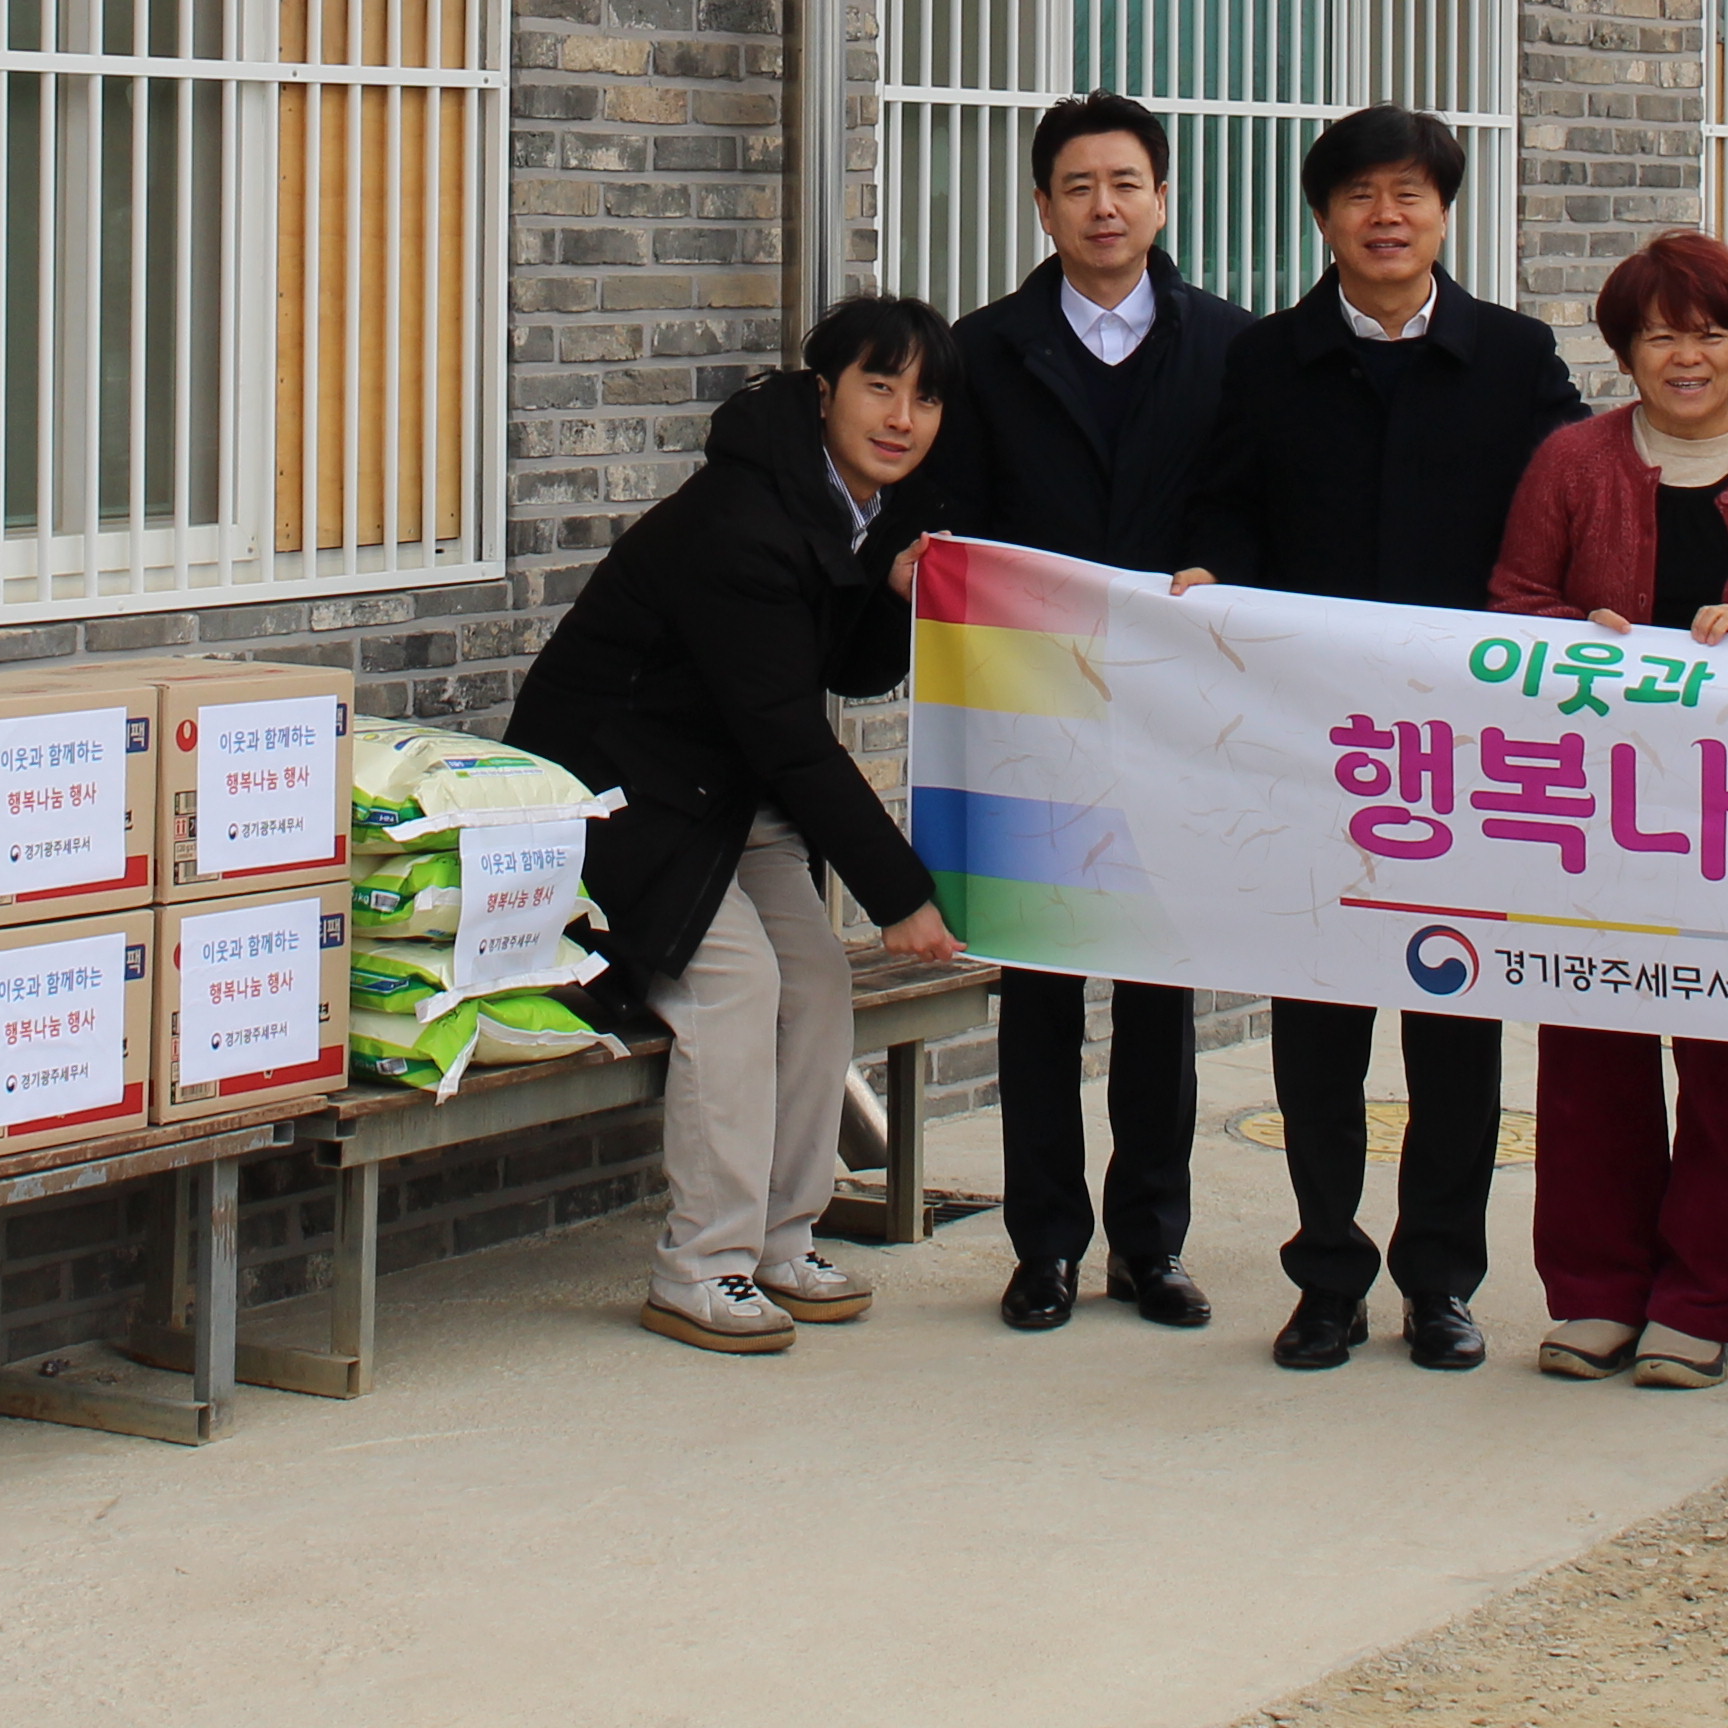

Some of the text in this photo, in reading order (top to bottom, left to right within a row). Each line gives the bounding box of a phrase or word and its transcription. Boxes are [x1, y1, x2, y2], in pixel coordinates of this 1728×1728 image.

[1468, 635, 1715, 718] 이웃과
[220, 725, 316, 754] 이웃과 함께하는
[0, 739, 104, 771] 이웃과 함께하는
[226, 765, 309, 795] 행복나눔 행사
[7, 781, 96, 815] 행복나눔 행사
[241, 817, 303, 838] 경기광주세무서
[24, 836, 90, 860] 경기광주세무서
[481, 848, 567, 876] 이웃과 함께하는
[487, 885, 554, 913] 행복나눔 행사
[203, 937, 243, 964] 이웃과
[247, 930, 300, 957] 함께하는
[487, 932, 540, 954] 경기광주세무서
[46, 966, 103, 996] 함께하는
[209, 969, 294, 1005] 행복나눔 행사
[4, 1008, 96, 1046] 행복나눔 행사
[225, 1021, 288, 1047] 경기광주세무서
[21, 1062, 88, 1089] 경기광주세무서
